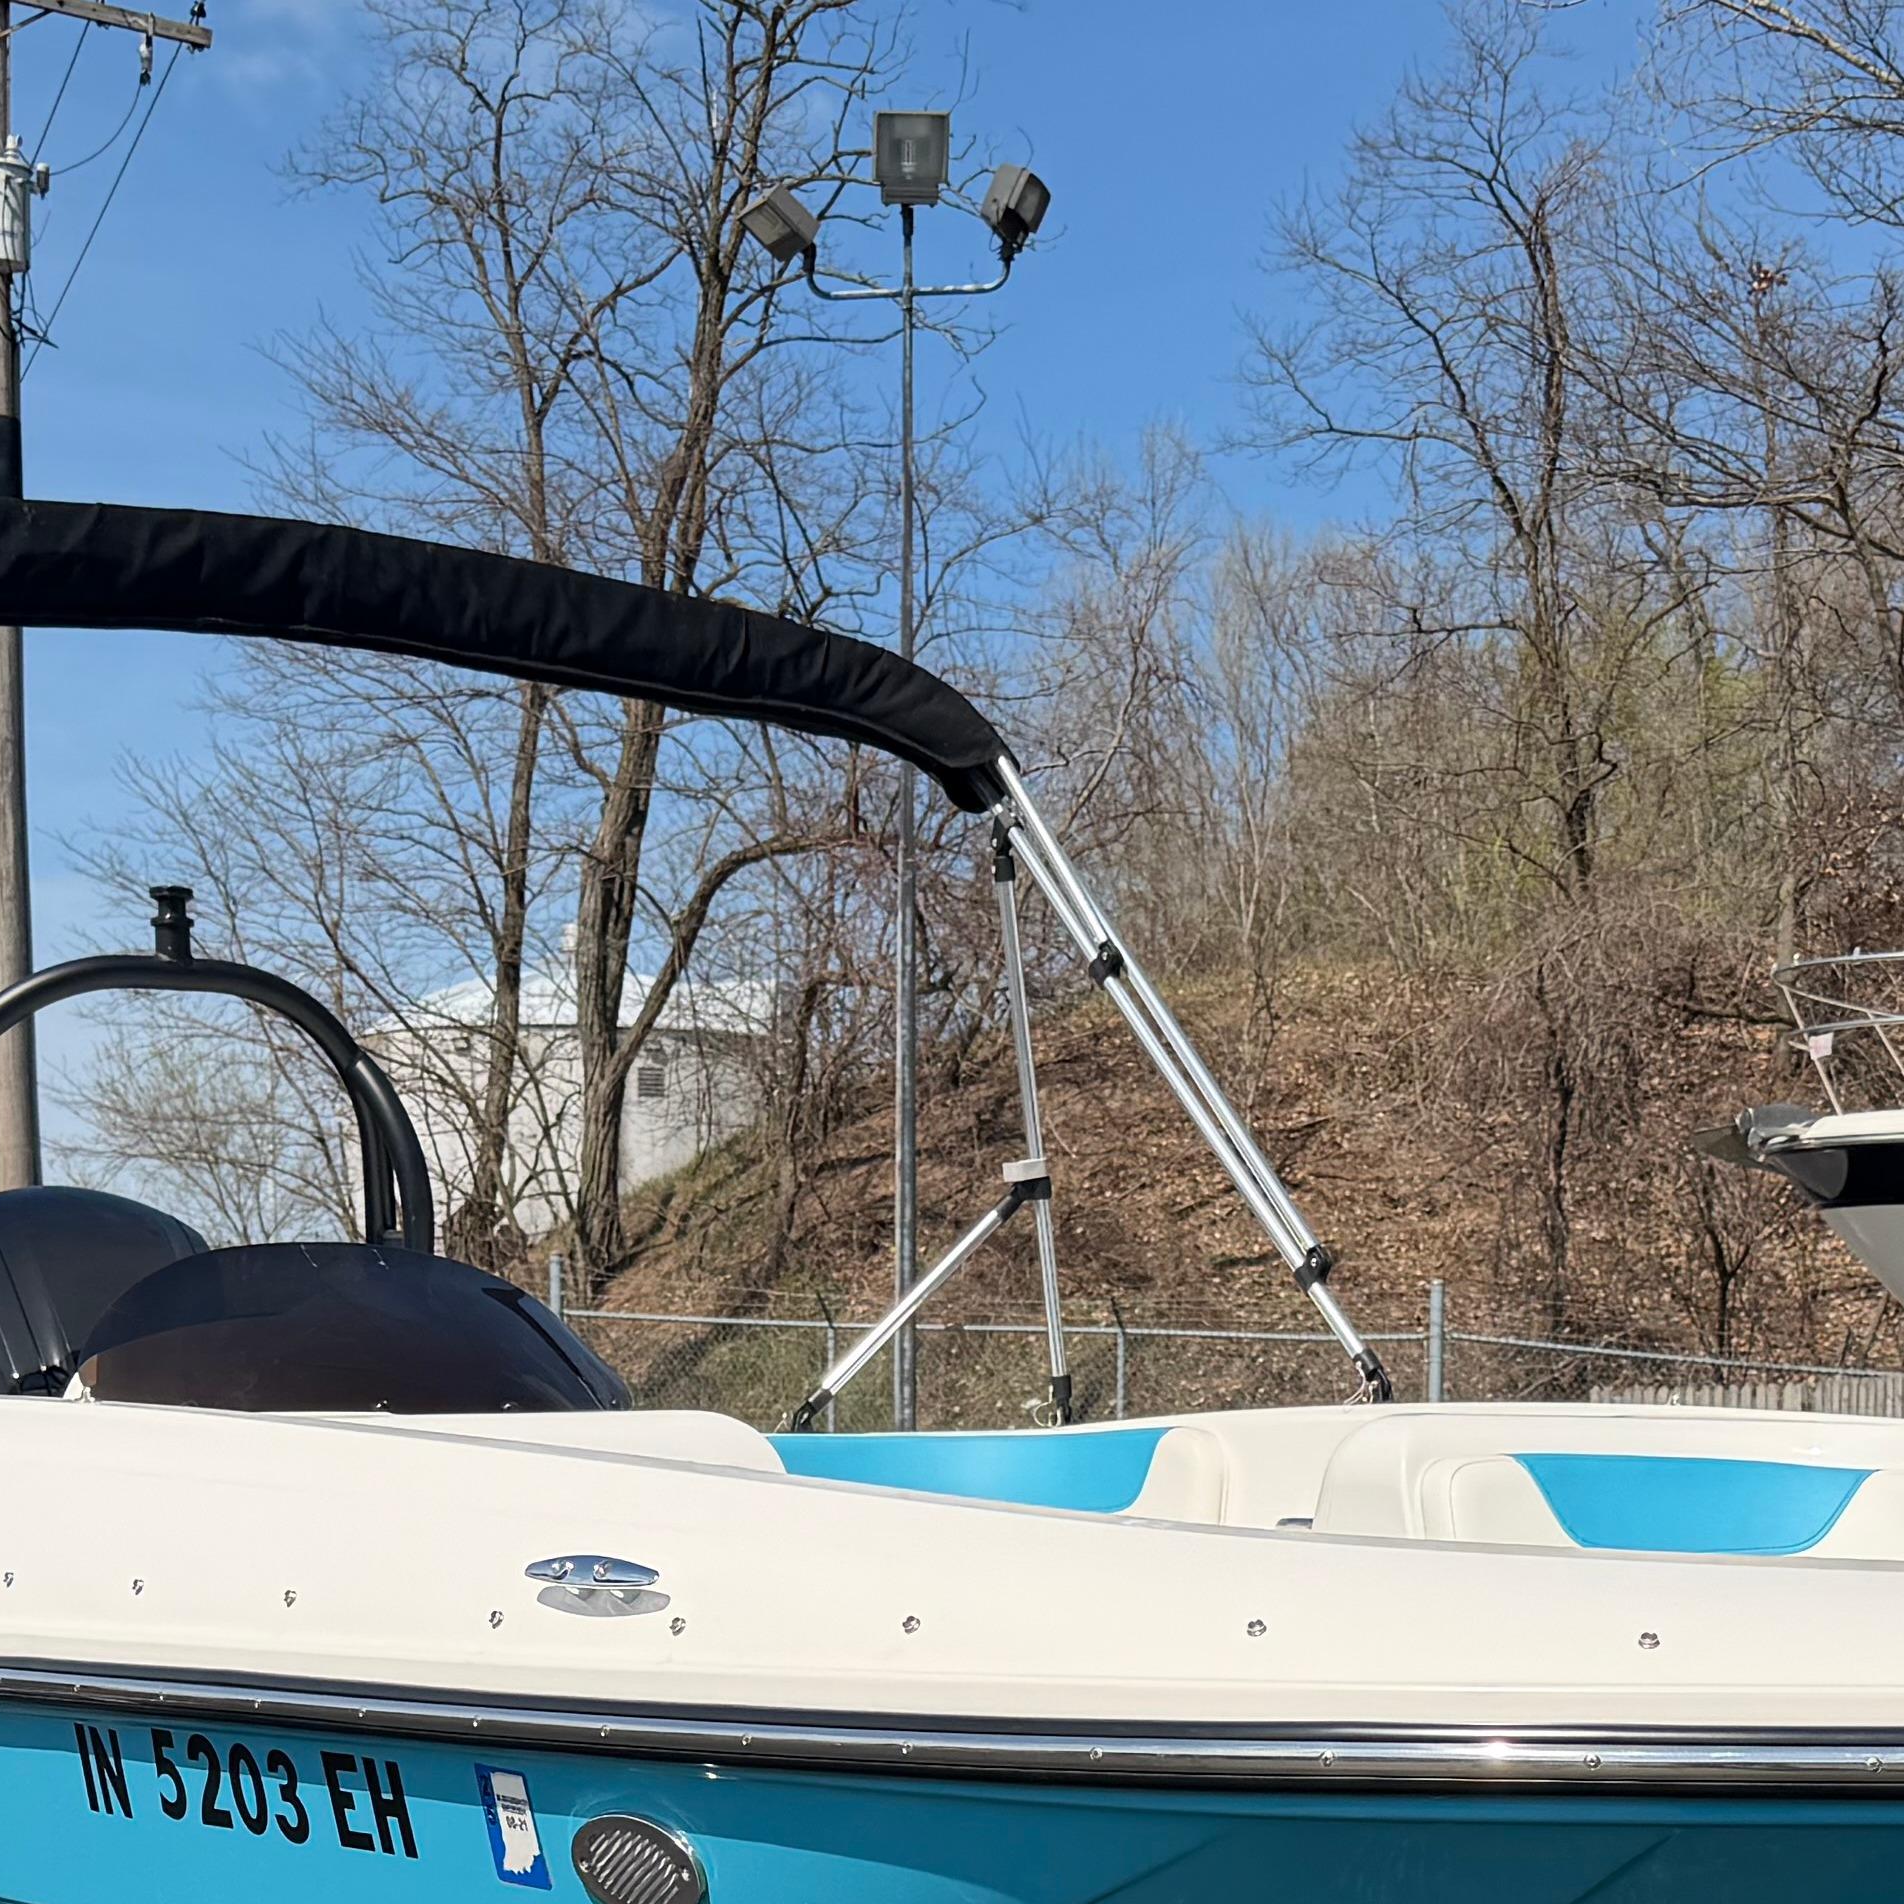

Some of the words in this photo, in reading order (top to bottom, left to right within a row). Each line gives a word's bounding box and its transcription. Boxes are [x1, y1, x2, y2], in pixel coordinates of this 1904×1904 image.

[73, 1722, 134, 1820] IN
[150, 1727, 311, 1846] 5203
[319, 1750, 420, 1860] EH
